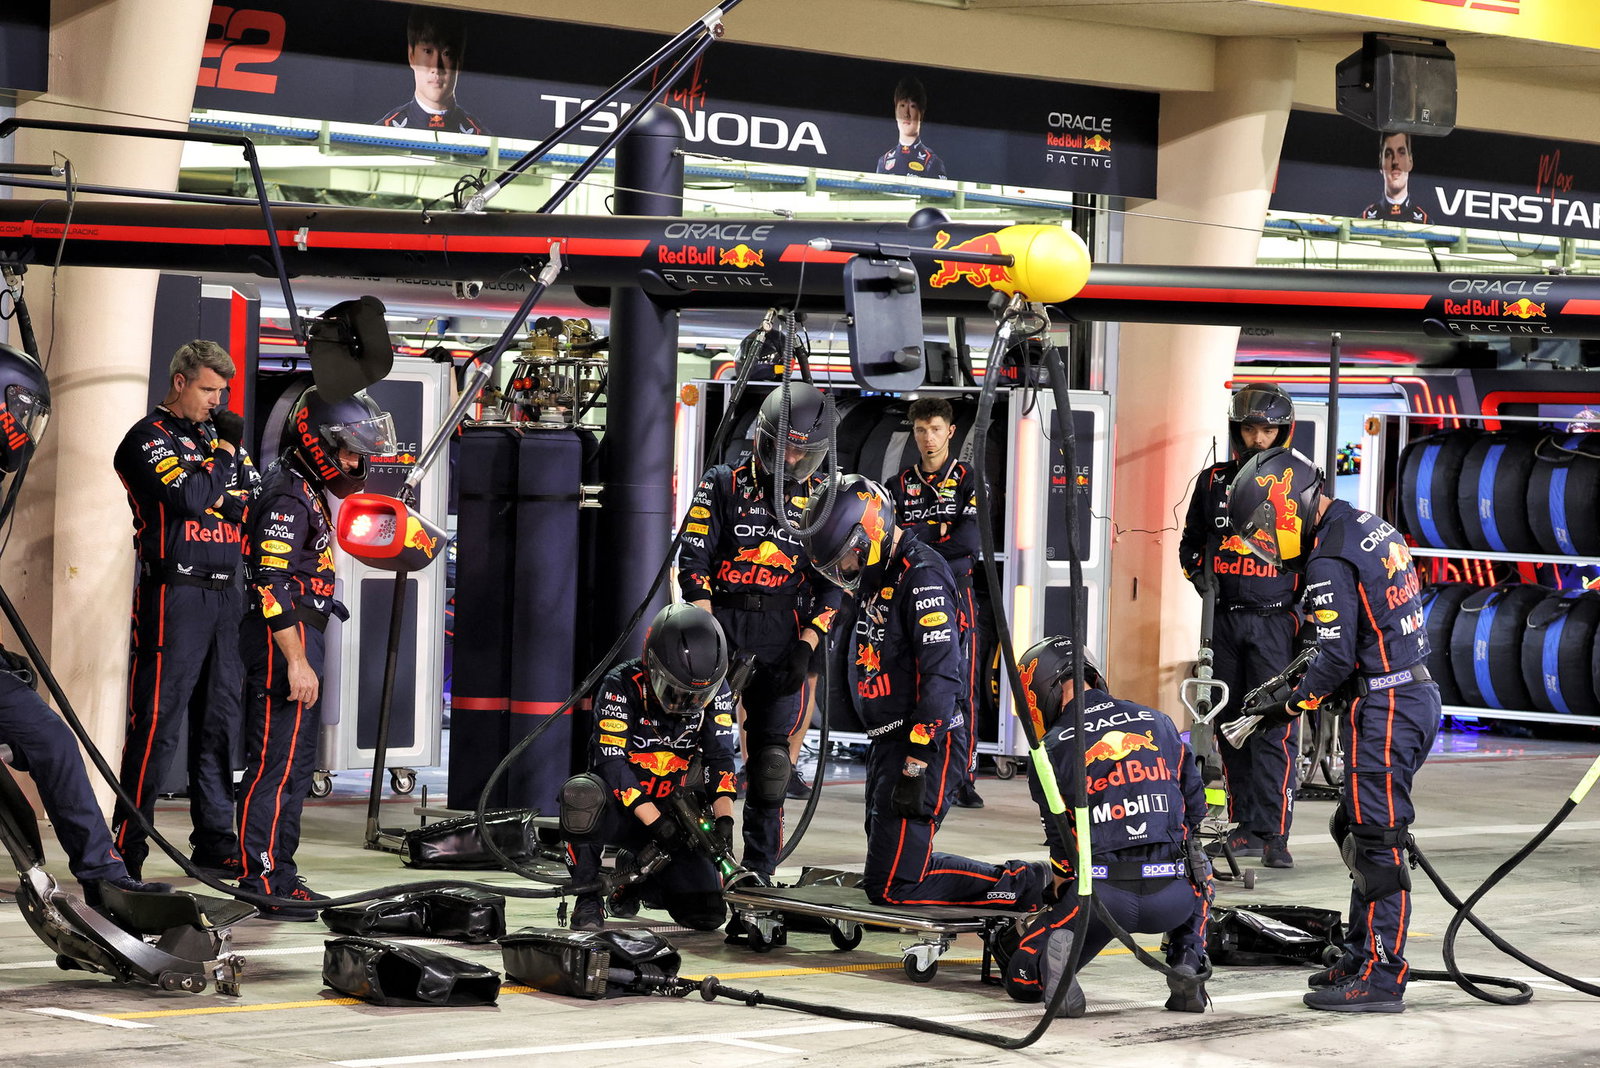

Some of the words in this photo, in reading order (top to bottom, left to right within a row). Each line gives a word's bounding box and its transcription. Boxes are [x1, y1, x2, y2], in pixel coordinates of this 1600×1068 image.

[1047, 111, 1112, 133] ORACLE
[1047, 132, 1064, 147] Red
[1065, 134, 1083, 149] Bull
[1046, 153, 1112, 169] RACING
[1537, 149, 1576, 206] Max
[1435, 186, 1600, 230] VERSTA
[664, 223, 774, 241] ORACLE
[658, 245, 686, 265] Red
[687, 246, 716, 265] Bull
[664, 273, 773, 287] RACING
[1448, 279, 1553, 296] ORACLE
[1444, 299, 1470, 315] Red
[1471, 300, 1499, 316] Bull
[1449, 323, 1553, 334] RACING
[295, 406, 320, 447] Red
[142, 438, 165, 451] Mobil
[151, 446, 169, 457] AVA
[148, 449, 176, 465] TRADE
[369, 466, 412, 474] RACIN
[270, 511, 295, 523] Mobil
[904, 504, 957, 521] ORACLE
[185, 520, 224, 543] Red
[264, 528, 295, 540] TRADE
[270, 523, 288, 533] AVA
[269, 543, 288, 551] RAUCH
[717, 560, 758, 585] Red
[1213, 556, 1242, 575] Red
[1242, 558, 1278, 578] Bull
[310, 577, 335, 597] Re
[915, 596, 945, 611] ROKT
[927, 615, 946, 623] RAUCH
[922, 628, 952, 643] HRC
[1370, 670, 1412, 690] sparco
[604, 691, 627, 704] Mobil
[600, 709, 628, 720] TRADE
[605, 704, 623, 713] AVA
[600, 746, 626, 757] VISA
[1092, 794, 1150, 824] Mobil
